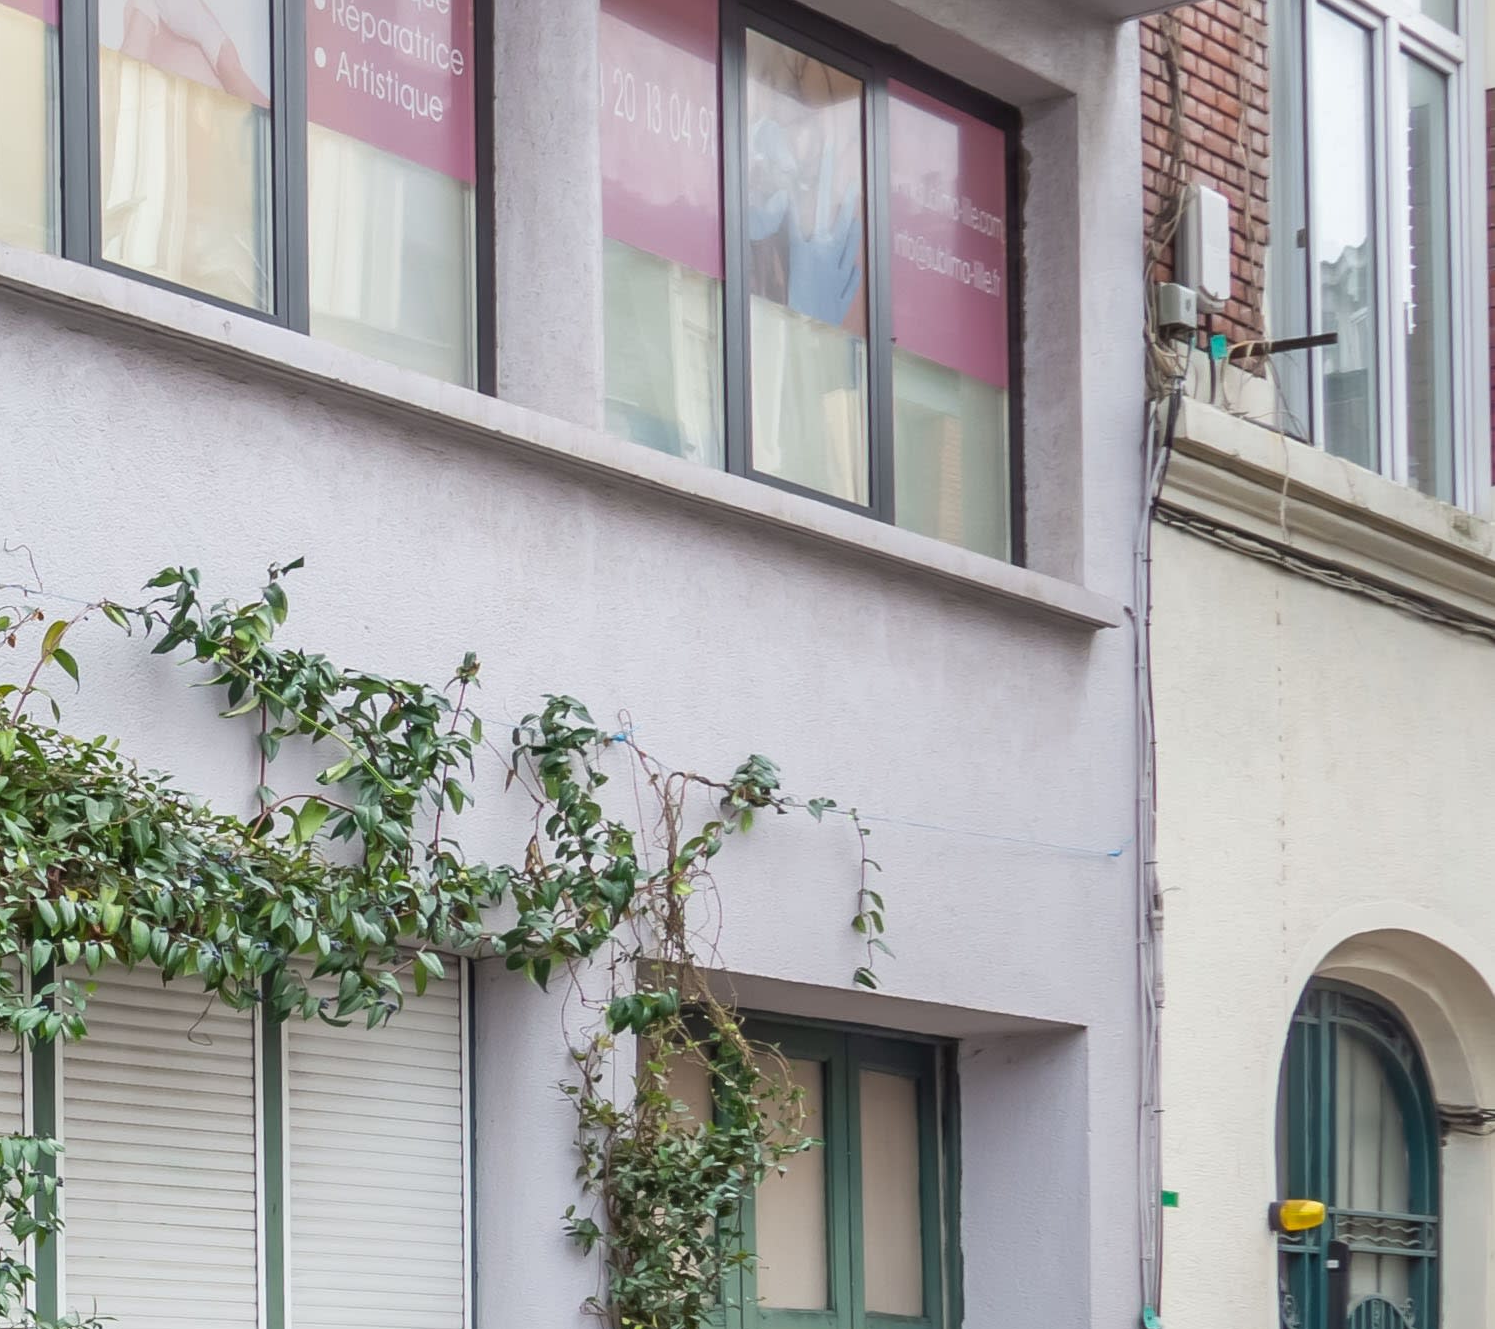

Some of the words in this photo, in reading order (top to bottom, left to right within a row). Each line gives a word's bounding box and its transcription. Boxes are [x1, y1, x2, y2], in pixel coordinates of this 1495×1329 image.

[336, 58, 444, 125] Artistique
[613, 69, 635, 122] 20
[670, 92, 691, 148] 04
